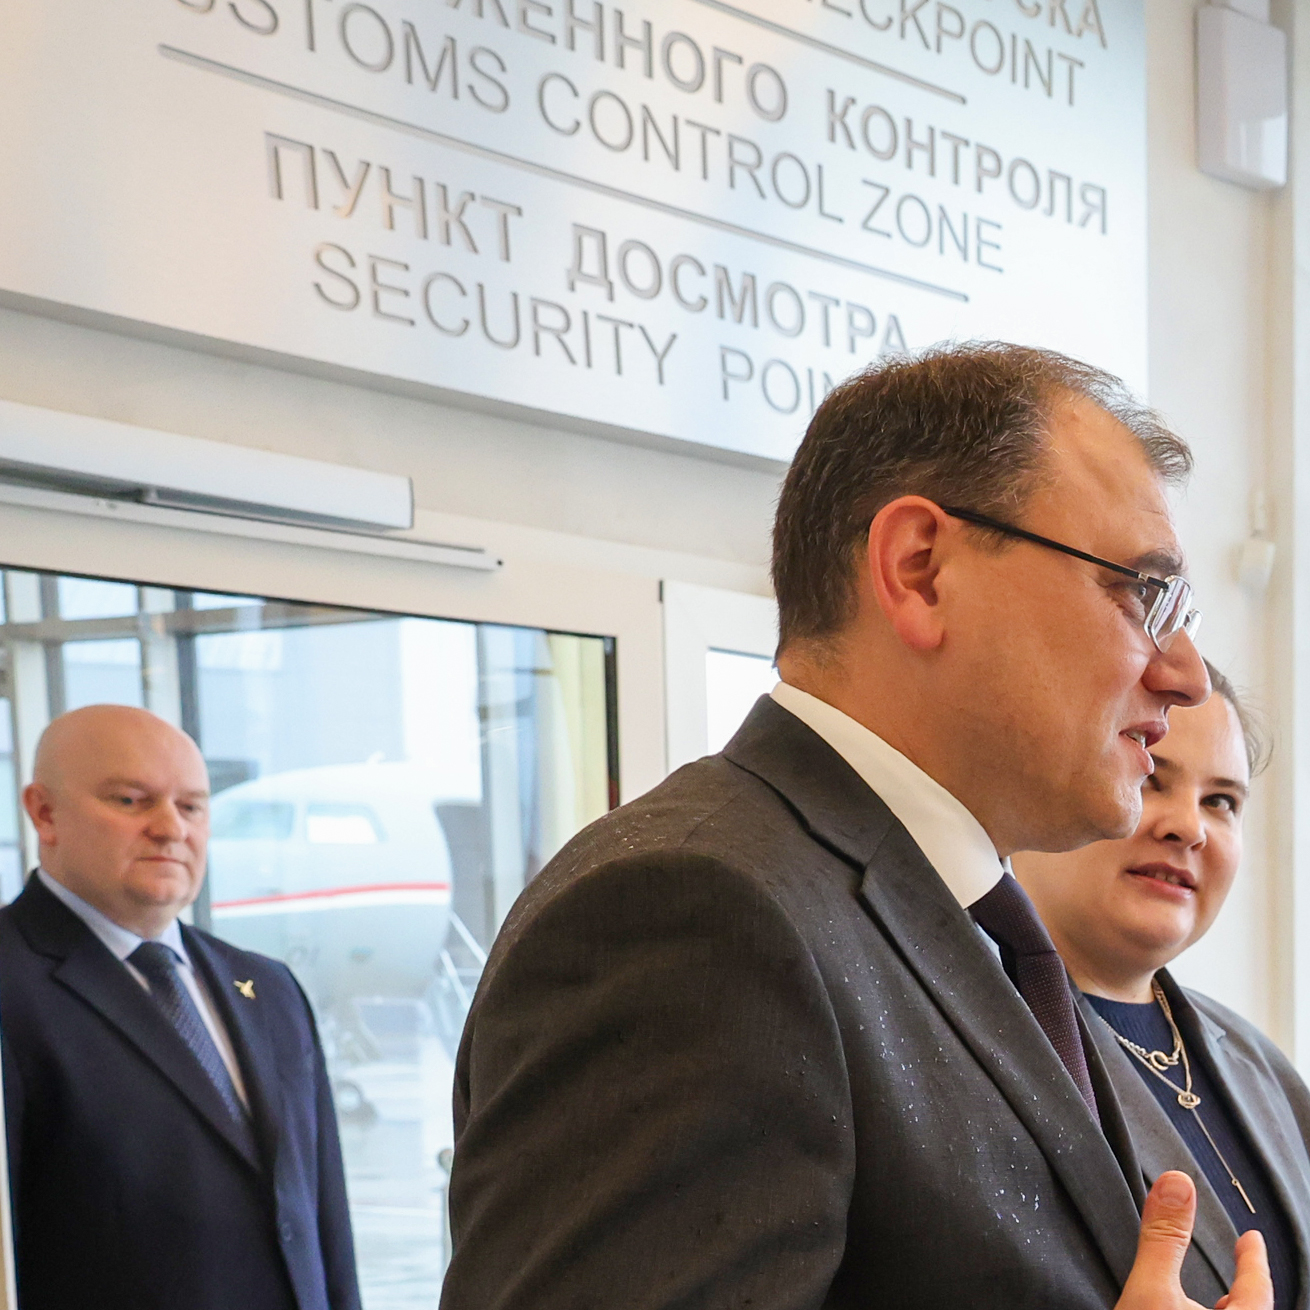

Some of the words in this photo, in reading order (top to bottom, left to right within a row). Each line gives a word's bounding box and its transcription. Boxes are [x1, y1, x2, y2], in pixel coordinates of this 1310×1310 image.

[264, 130, 524, 263] ПУНКТ
[566, 222, 909, 355] ДОСМОТРА
[537, 71, 845, 225] CONTROL
[861, 178, 1005, 274] ZONE
[825, 88, 1108, 236] КОНТРОЛЯ
[312, 241, 678, 386] SECURITY
[719, 344, 840, 416] POI
